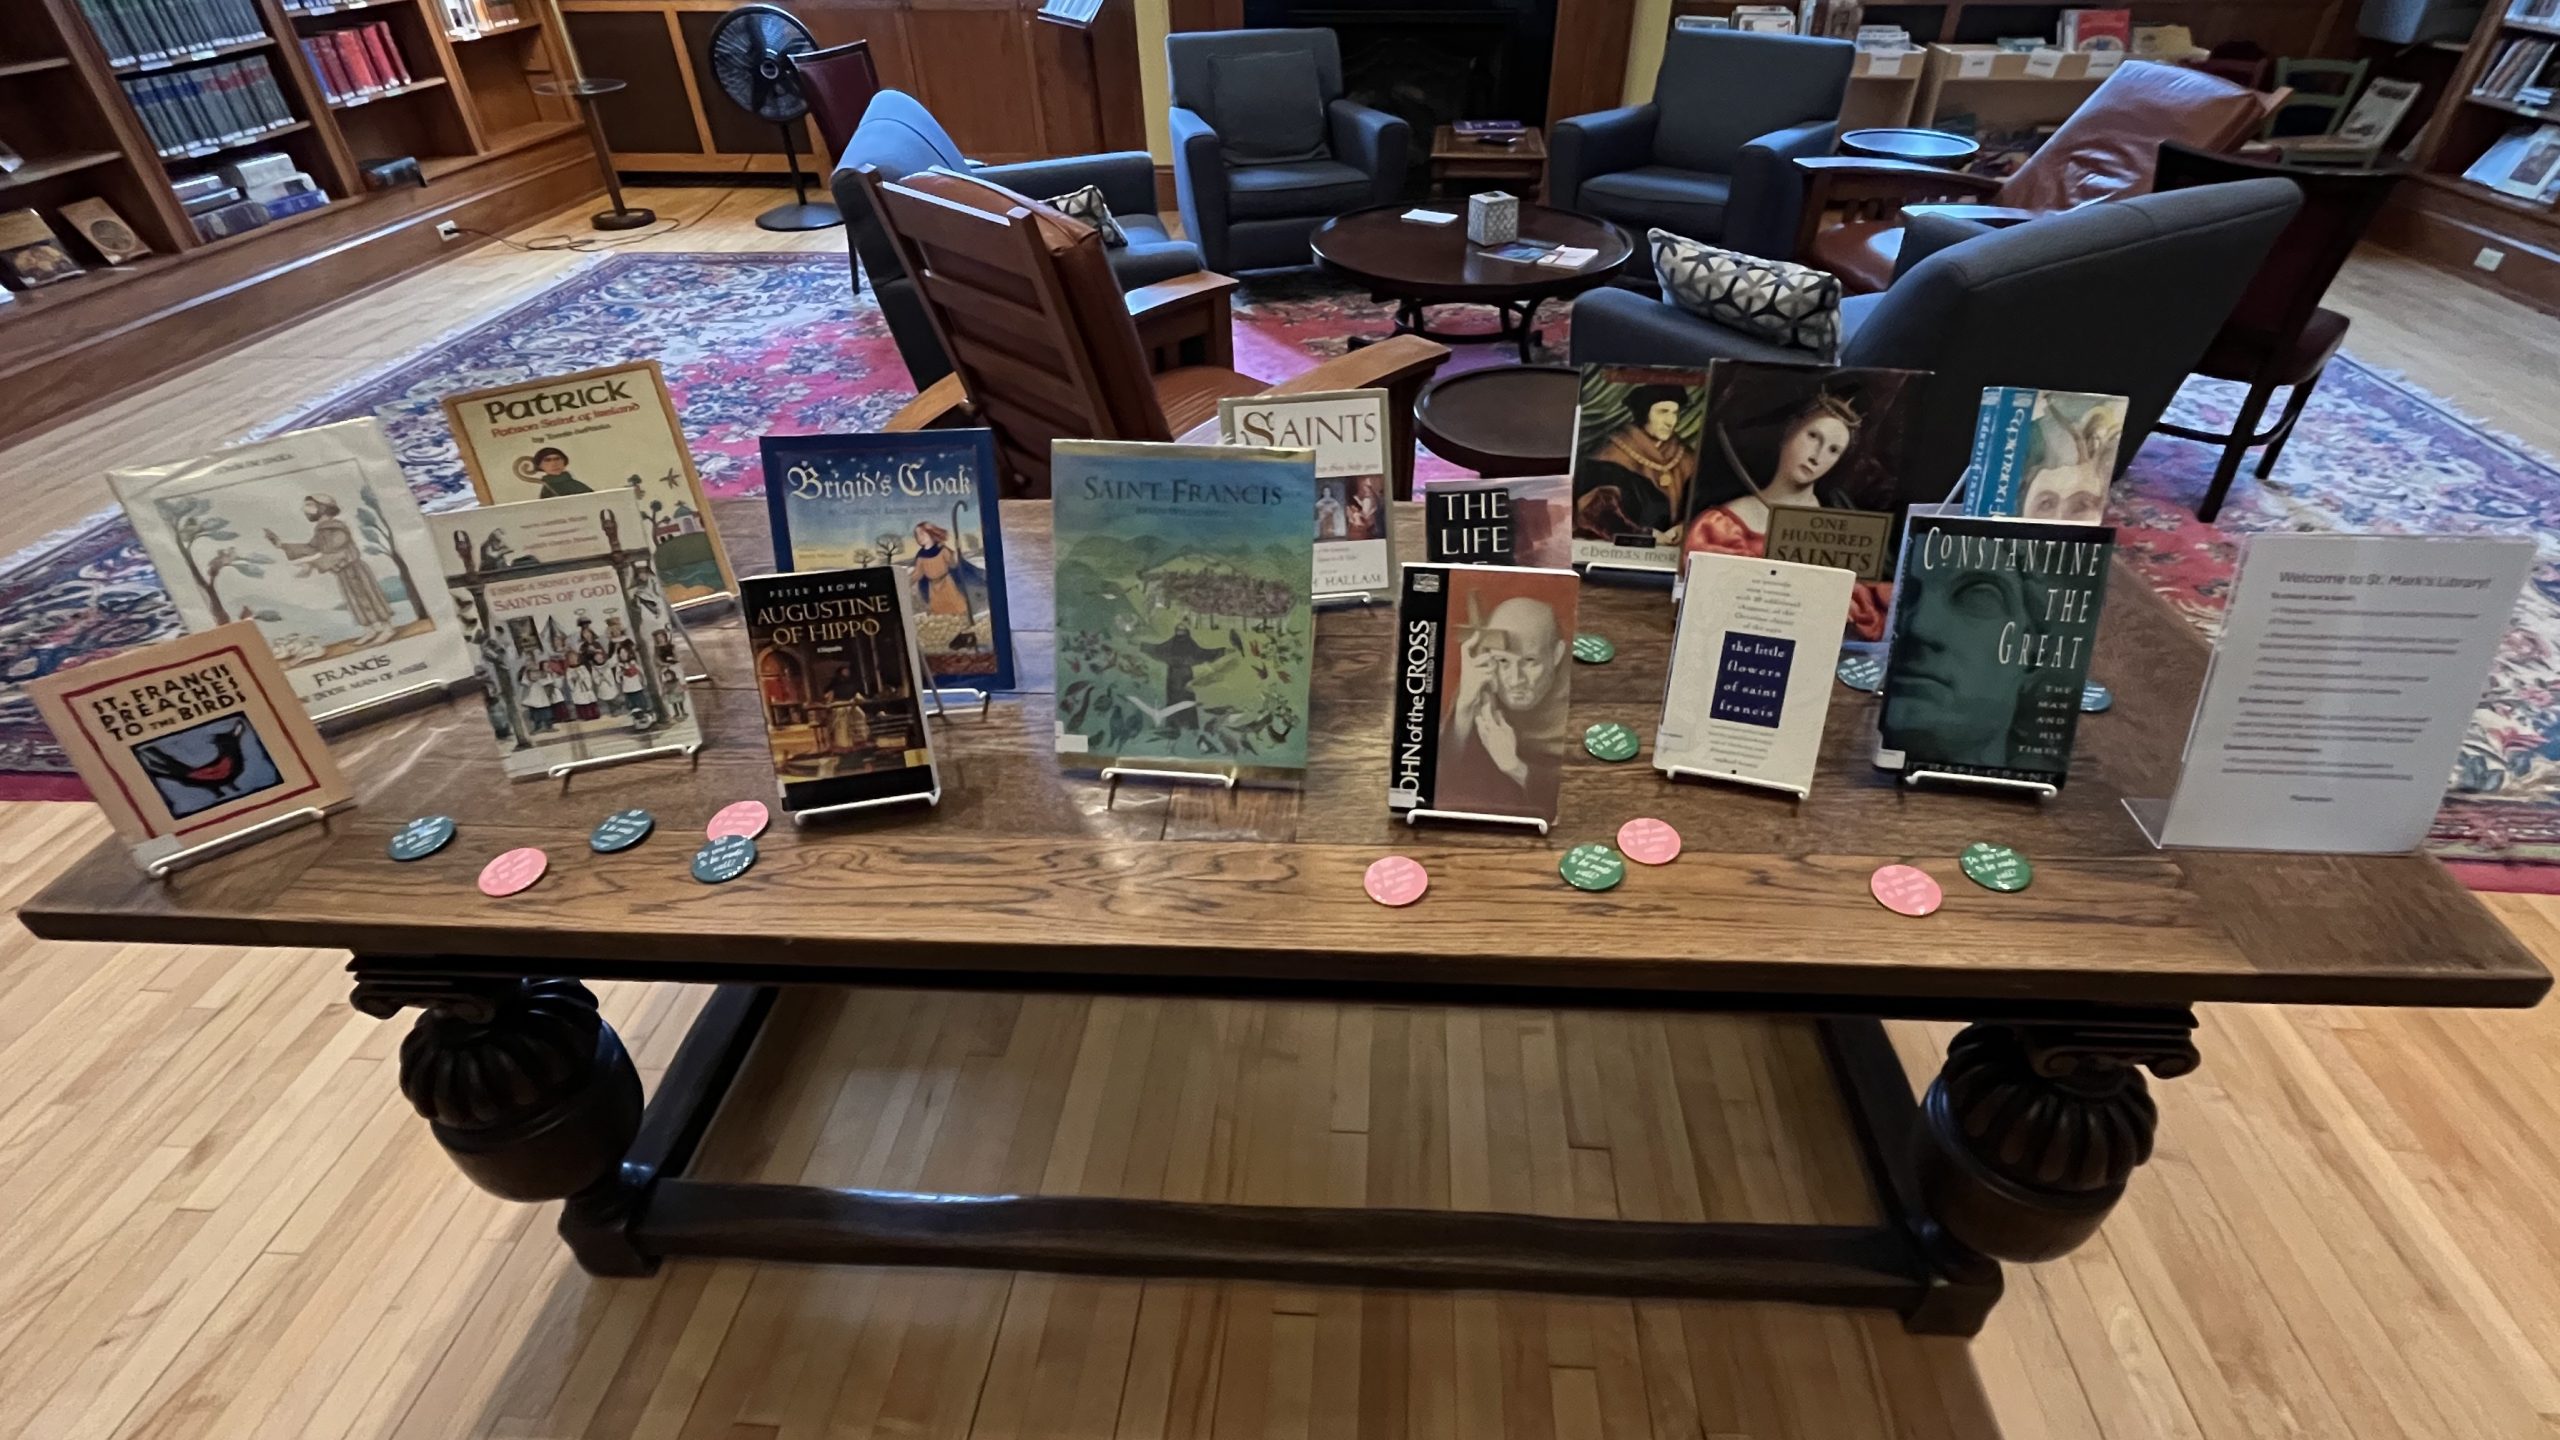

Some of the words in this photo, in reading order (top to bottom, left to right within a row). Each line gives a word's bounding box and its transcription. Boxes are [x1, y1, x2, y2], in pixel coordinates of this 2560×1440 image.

[1240, 411, 1377, 447] SAINTS
[787, 465, 893, 504] Brigid's
[897, 463, 971, 497] Cloak
[1439, 491, 1509, 521] THE
[1809, 516, 1849, 531] ONE
[1441, 526, 1510, 555] LIFE
[1781, 528, 1873, 548] HUNDRED
[1777, 545, 1872, 572] SAINTS
[769, 587, 810, 598] PETER
[818, 581, 868, 594] BROWN
[1325, 573, 1381, 586] HALLAM
[2279, 571, 2346, 586] Welcome
[2349, 573, 2364, 586] to
[493, 593, 553, 612] SAINTS
[556, 590, 575, 602] OF
[580, 583, 617, 599] GOD
[757, 595, 891, 625] AUGUSTINE
[2044, 588, 2093, 624] THE
[772, 626, 804, 646] OF
[808, 617, 880, 642] HIPPO
[1406, 619, 1430, 695] CROSS
[1731, 640, 1752, 653] the
[1754, 643, 1786, 658] little
[1998, 621, 2084, 670] GREAT
[312, 655, 391, 688] FRANCIS
[1726, 659, 1782, 678] flowers
[130, 664, 230, 703] FRANCIS
[1723, 680, 1739, 693] of
[1742, 685, 1777, 698] saint
[2044, 684, 2073, 695] THE
[100, 676, 239, 729] PREACHES
[107, 722, 143, 741] TO
[178, 690, 247, 721] BIRDS
[1719, 699, 1774, 717] francis
[2036, 700, 2069, 710] MAN
[2036, 715, 2066, 726] AND
[2038, 731, 2065, 741] HIS
[2017, 744, 2060, 756] TIMES
